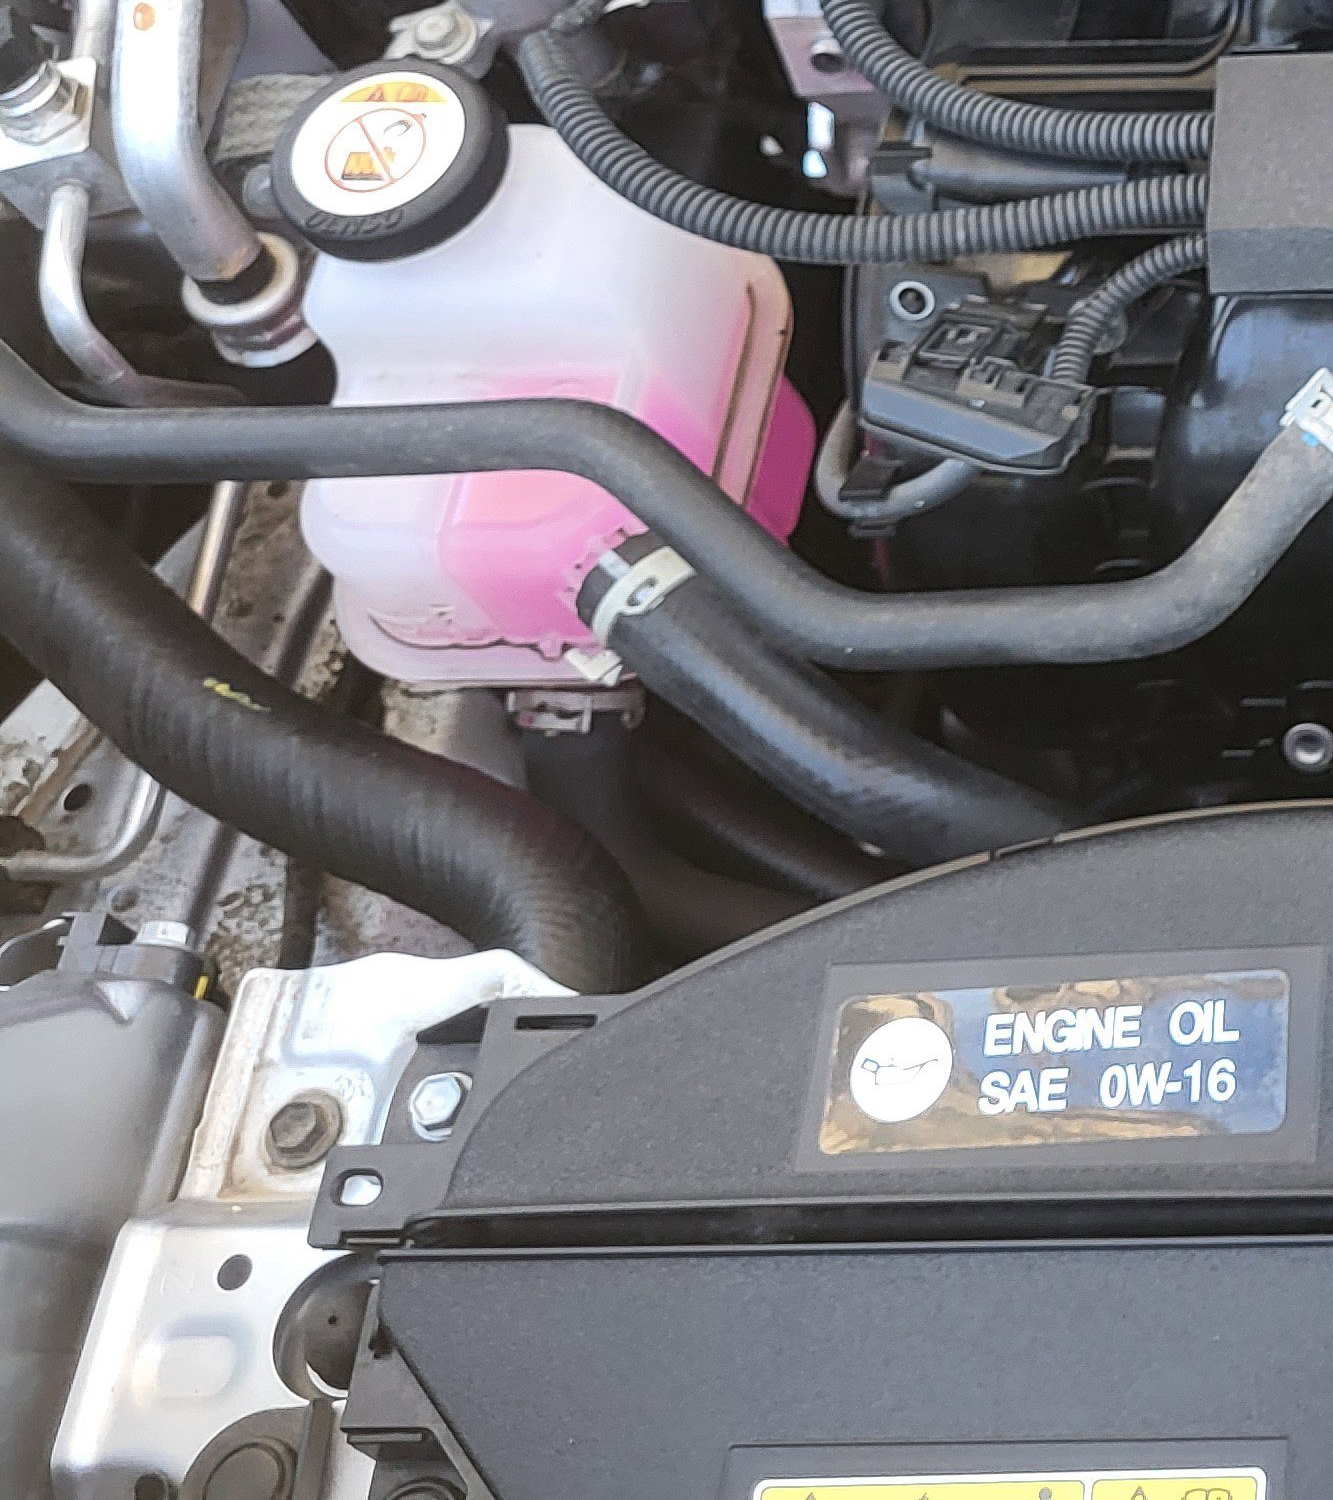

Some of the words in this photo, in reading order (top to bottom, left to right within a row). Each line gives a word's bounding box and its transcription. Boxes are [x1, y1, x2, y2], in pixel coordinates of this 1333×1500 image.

[982, 1003, 1144, 1058] ENGINE
[1168, 999, 1241, 1046] OIL
[978, 1066, 1071, 1116] SAE
[1099, 1057, 1237, 1110] 0W-16
